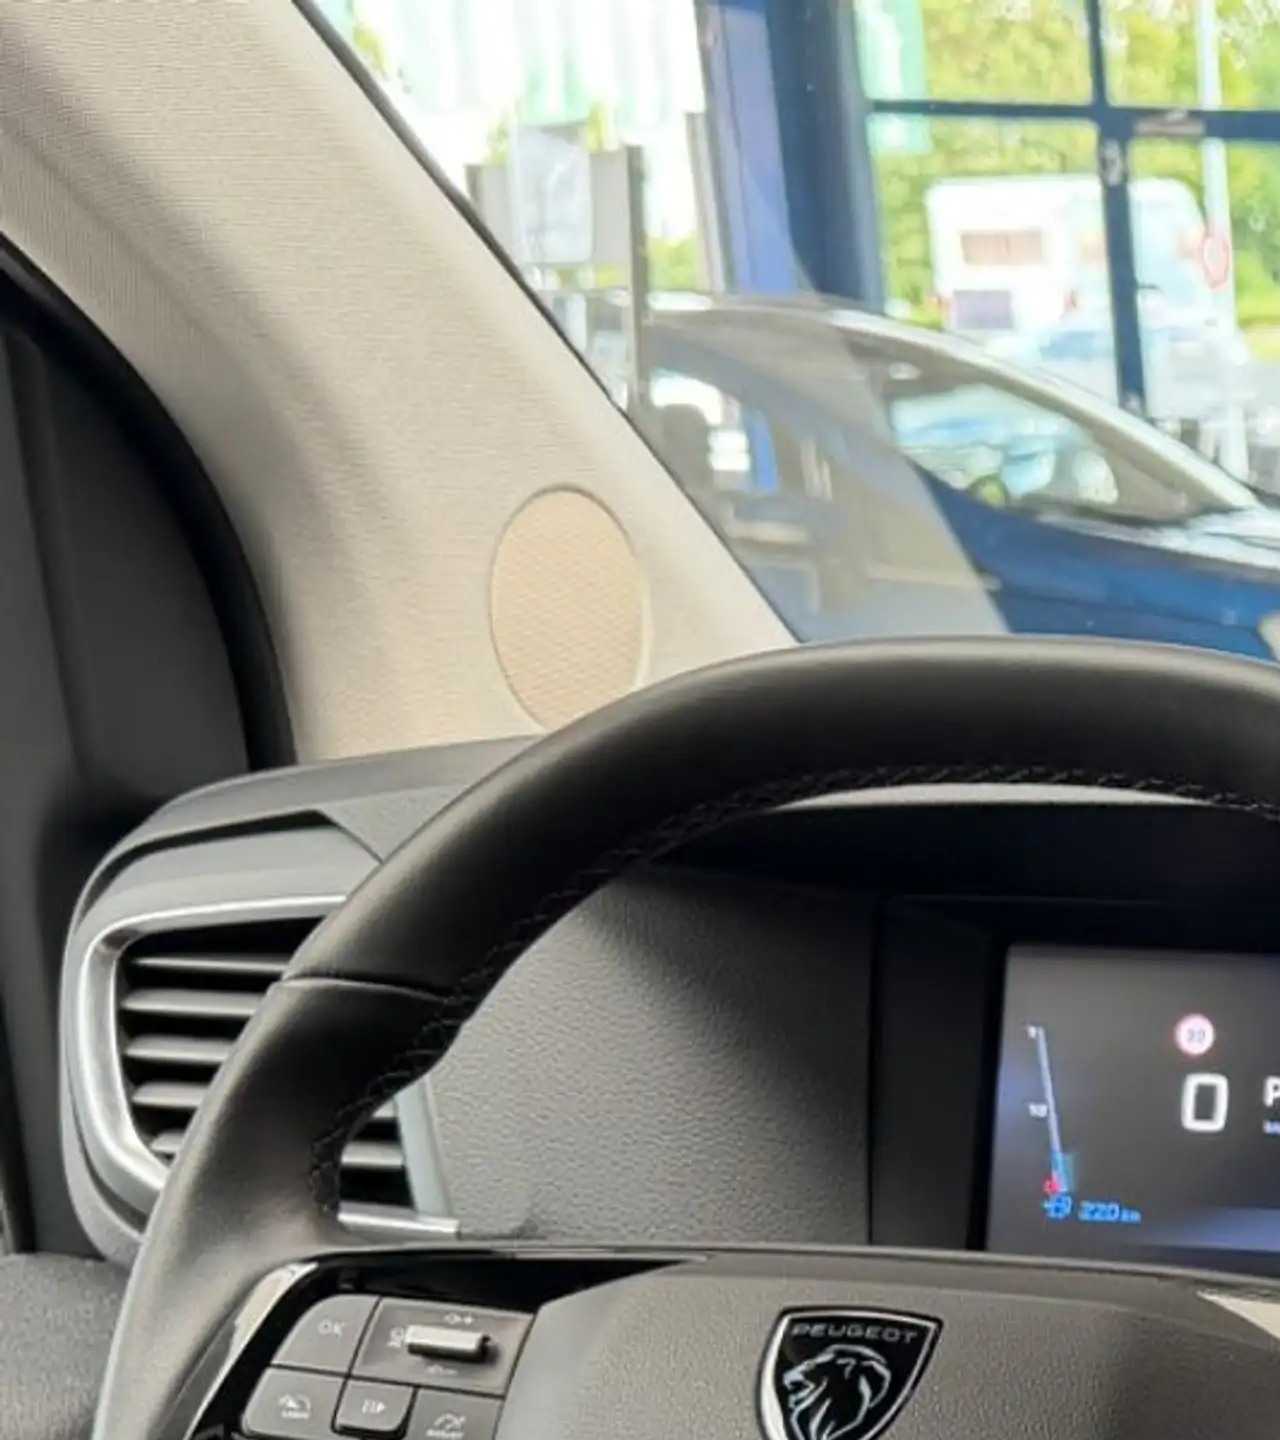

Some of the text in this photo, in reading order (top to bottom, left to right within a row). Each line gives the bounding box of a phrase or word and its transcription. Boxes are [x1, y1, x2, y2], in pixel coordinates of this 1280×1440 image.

[1181, 1072, 1229, 1133] 0
[1078, 1200, 1120, 1222] 220
[790, 1322, 918, 1345] PEUGEOT
